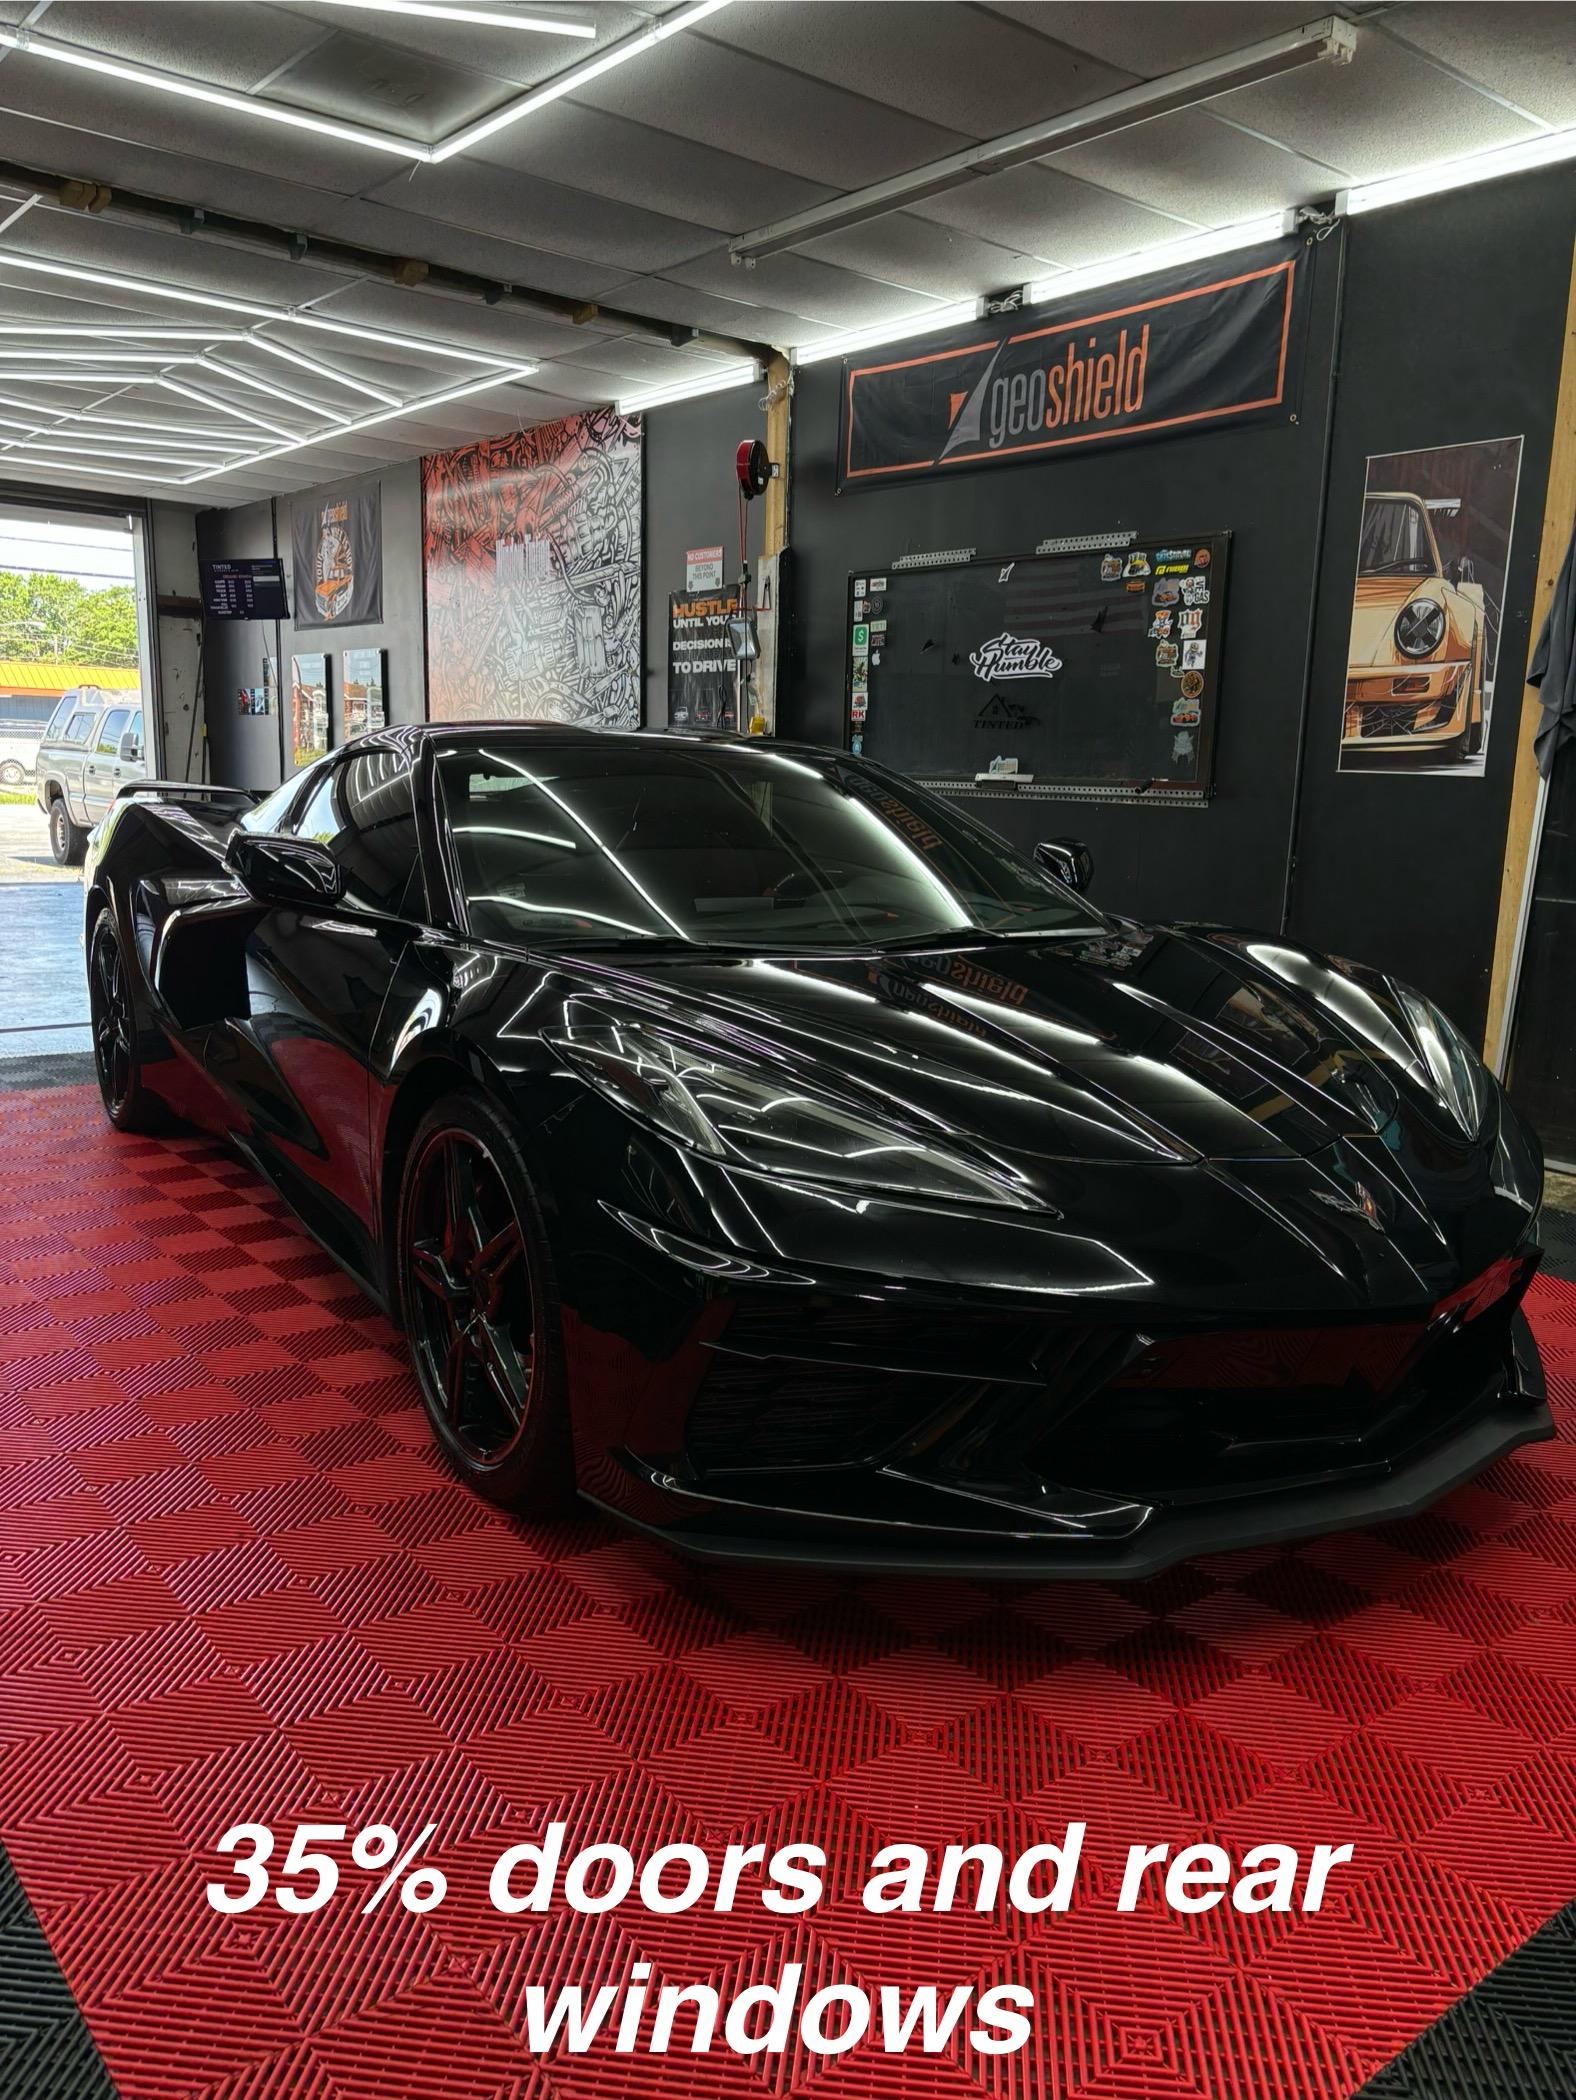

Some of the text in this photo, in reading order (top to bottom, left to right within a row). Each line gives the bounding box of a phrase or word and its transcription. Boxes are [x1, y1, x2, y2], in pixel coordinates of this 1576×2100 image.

[988, 323, 1150, 449] geoshield
[672, 598, 737, 618] HUSTLE
[673, 616, 704, 629] UNTIL
[672, 638, 724, 651] DECISION
[980, 633, 1040, 659] Stay
[672, 659, 736, 674] TO DRIVE
[970, 647, 1061, 681] Humble
